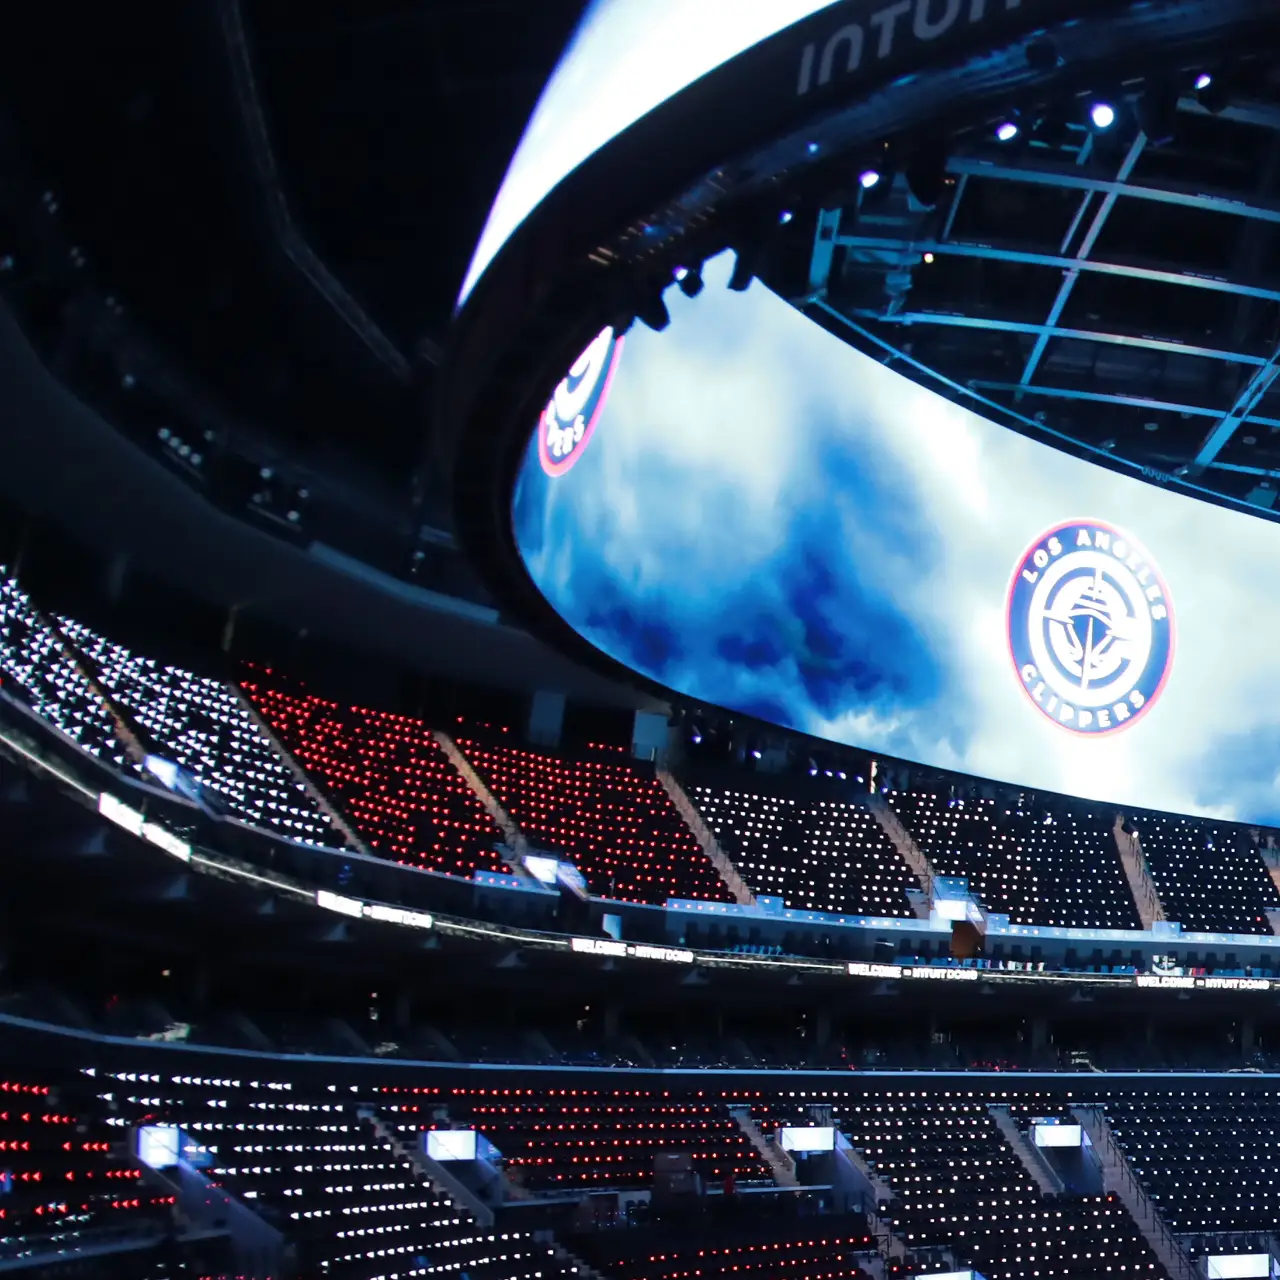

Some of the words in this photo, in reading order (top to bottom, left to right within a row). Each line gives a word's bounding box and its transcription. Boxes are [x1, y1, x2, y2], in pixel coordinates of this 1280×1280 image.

[796, 0, 1021, 96] INTU
[1022, 537, 1063, 583] LOS
[1076, 529, 1167, 620] ANGELES
[1021, 664, 1145, 728] CLIPPERS
[848, 963, 901, 978] WELCOME
[1136, 976, 1195, 988] WELCOME
